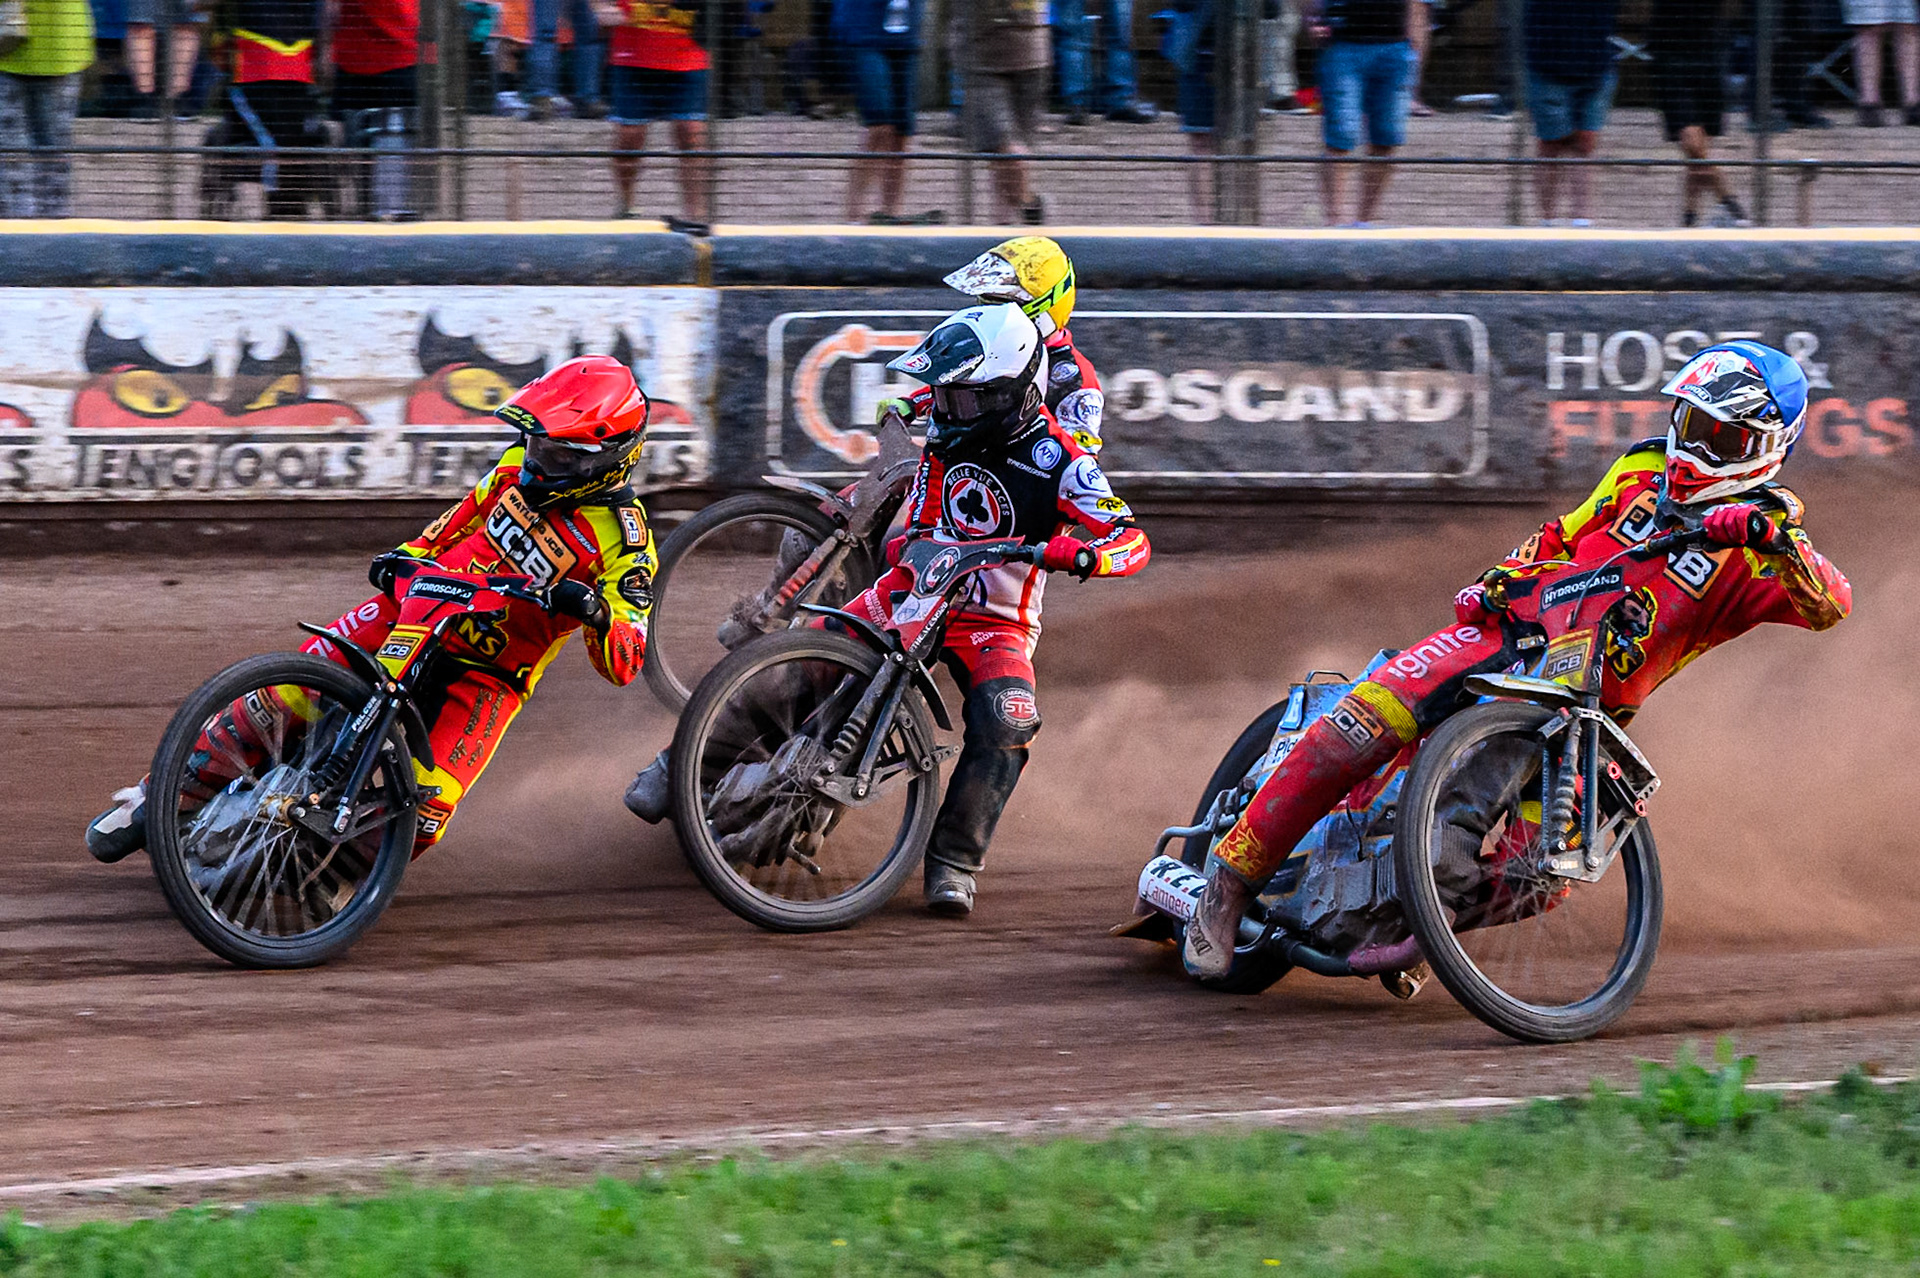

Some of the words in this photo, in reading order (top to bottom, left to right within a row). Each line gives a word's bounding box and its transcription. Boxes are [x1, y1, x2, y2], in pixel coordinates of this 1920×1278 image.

[1547, 330, 1763, 391] HOS
[1682, 384, 1711, 402] SHOEI
[1547, 398, 1915, 458] FITGS
[947, 467, 970, 486] BELLE
[973, 469, 993, 487] VUE
[993, 488, 1010, 517] ACES
[623, 510, 640, 543] JCB
[487, 515, 554, 588] JCB
[544, 535, 565, 559] JCB
[380, 645, 410, 657] JCB
[1386, 625, 1483, 681] ignite
[1548, 655, 1581, 676] JCB
[1003, 701, 1034, 714] STS
